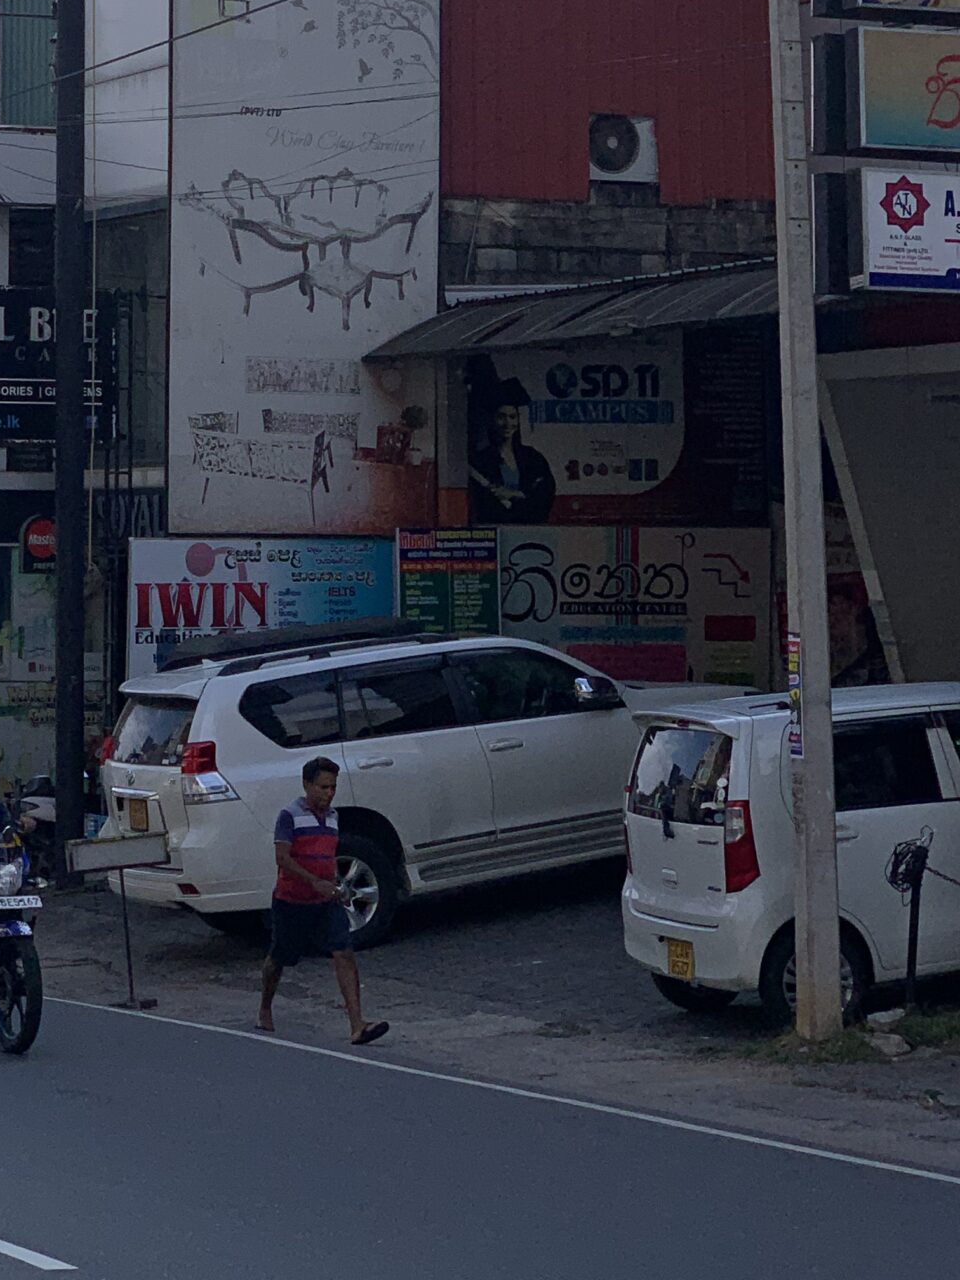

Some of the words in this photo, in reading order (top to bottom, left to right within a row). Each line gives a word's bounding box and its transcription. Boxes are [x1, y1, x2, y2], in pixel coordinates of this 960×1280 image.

[28, 534, 56, 545] Maste
[224, 541, 262, 569] උසස්
[266, 548, 302, 568] පෙළ
[328, 586, 356, 597] IELTS
[135, 582, 269, 629] IWIN
